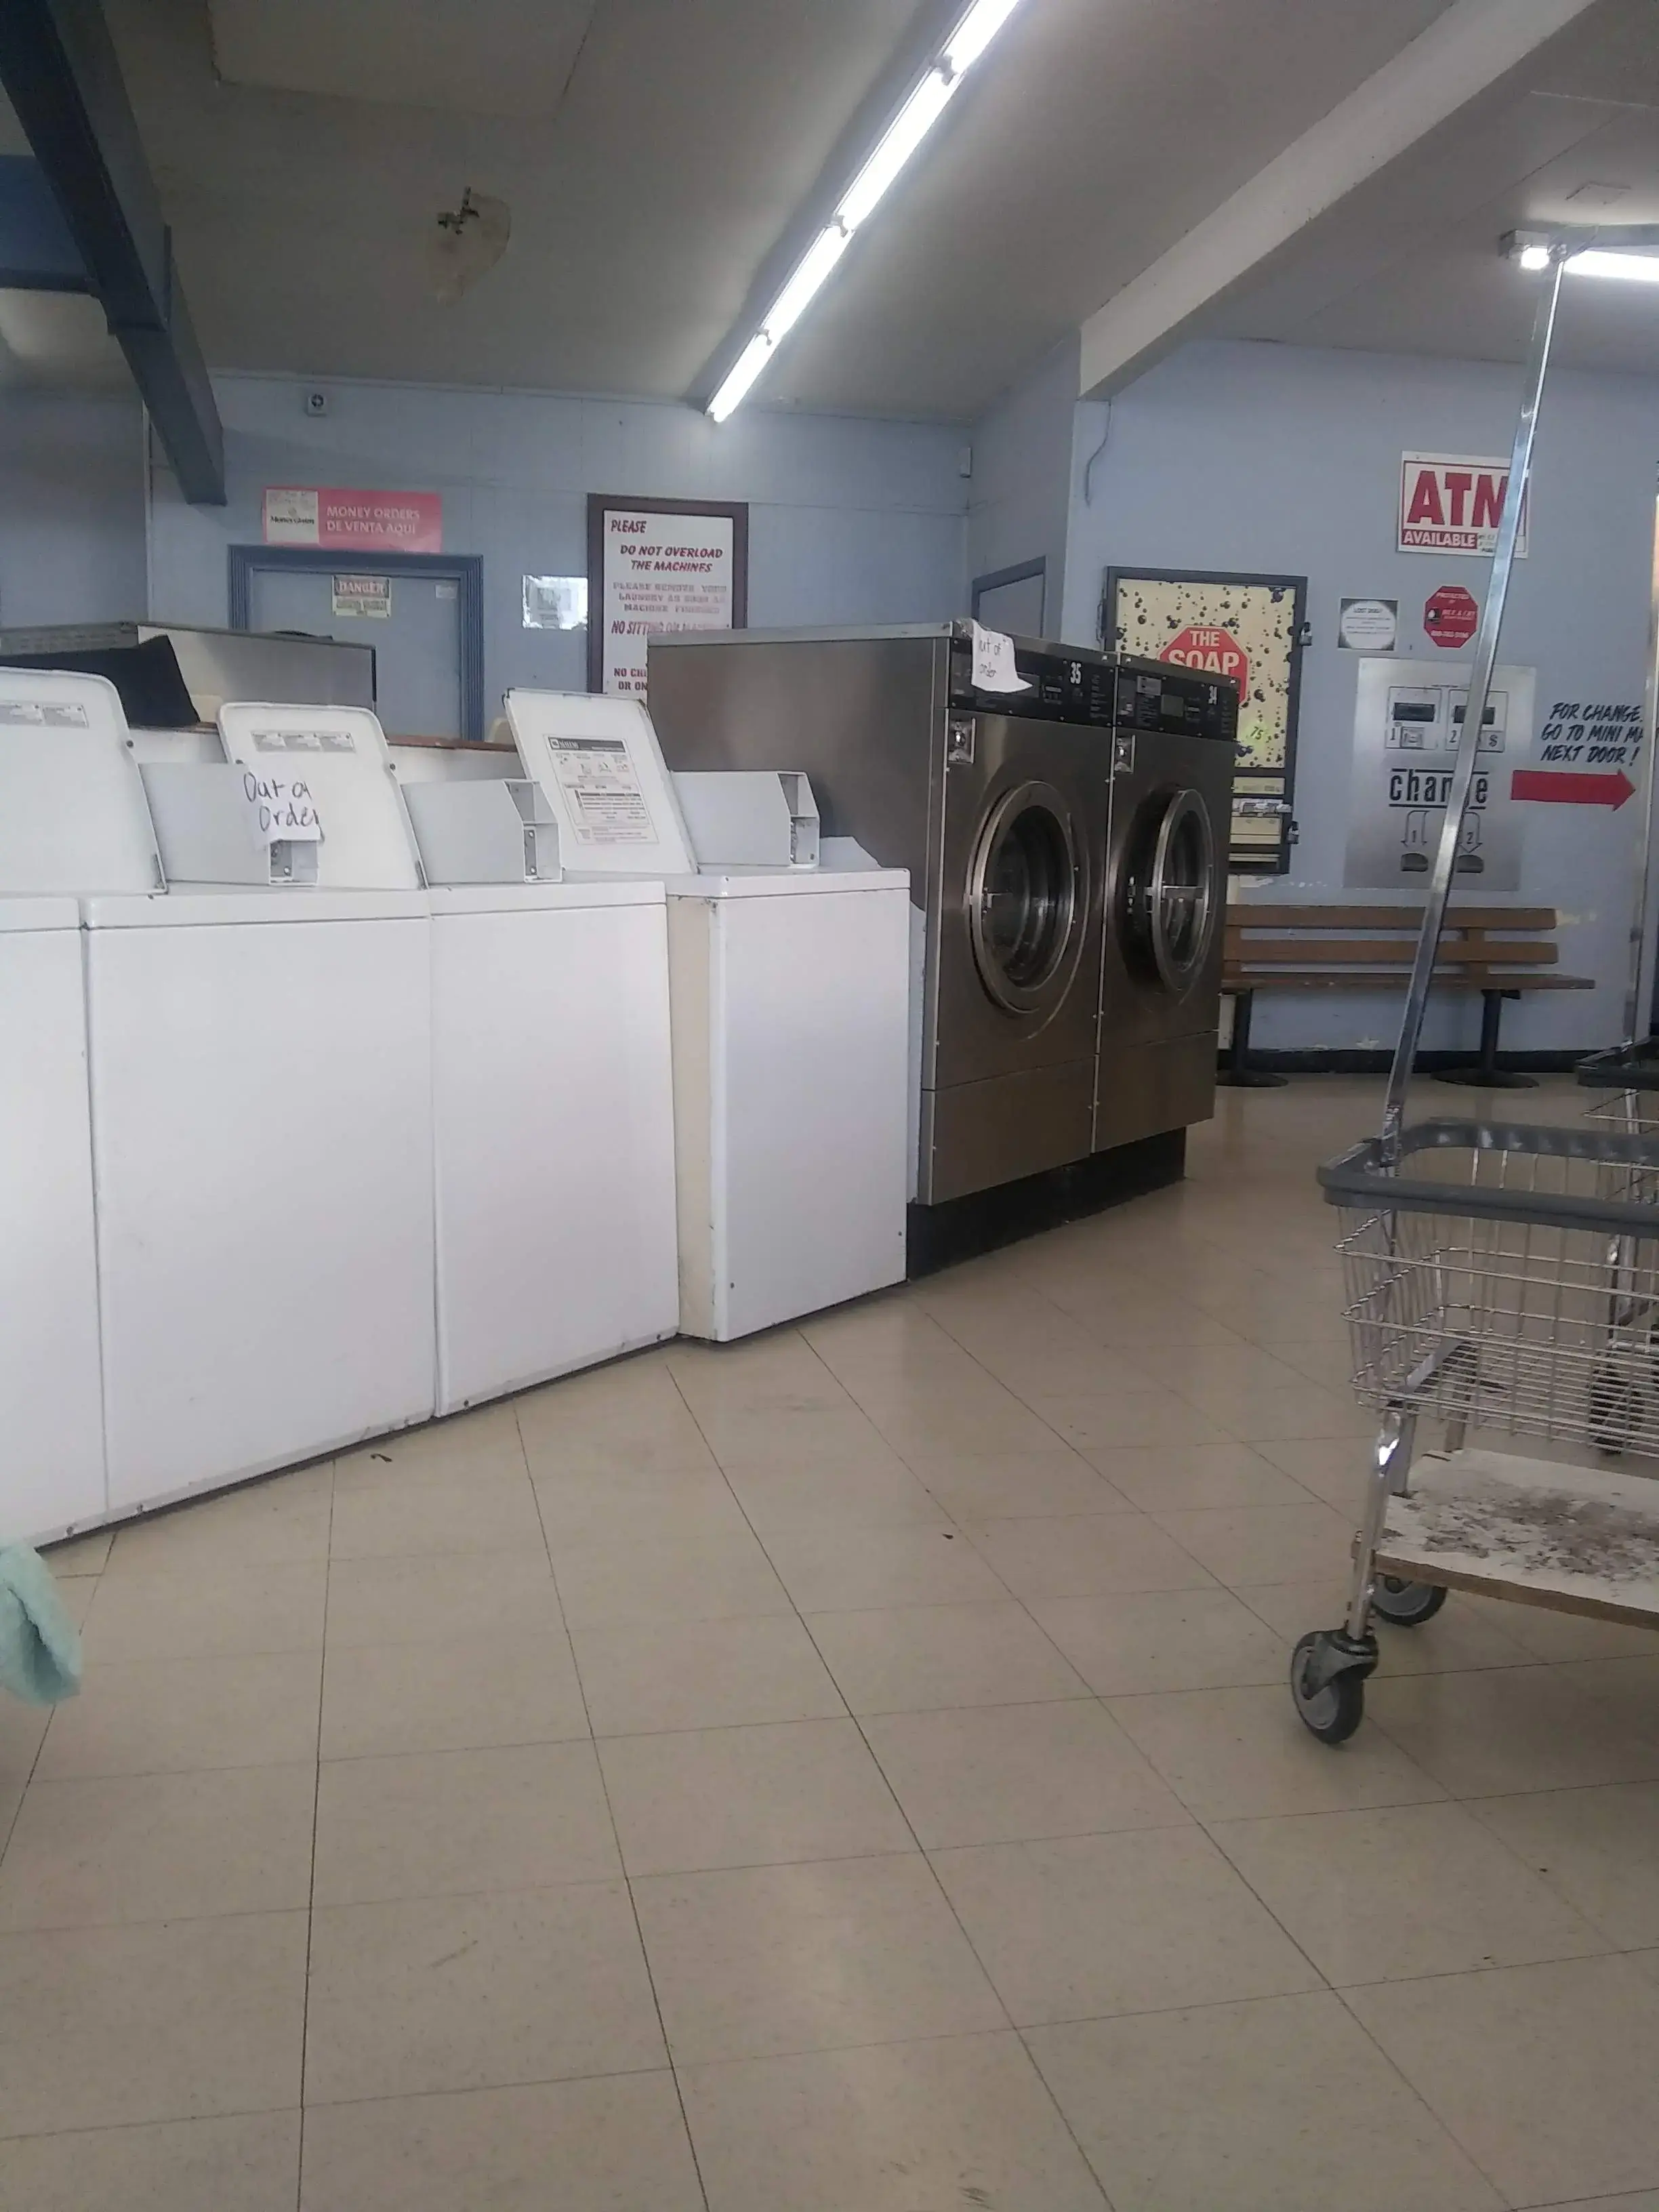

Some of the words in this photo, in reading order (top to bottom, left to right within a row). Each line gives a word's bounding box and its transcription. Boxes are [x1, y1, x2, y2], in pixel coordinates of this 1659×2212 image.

[326, 506, 371, 519] MONEY
[373, 509, 421, 520] ORDERS
[326, 520, 342, 532] DE
[345, 522, 384, 534] VENTA
[611, 520, 647, 534] PLEASE
[1403, 531, 1475, 548] AVAILABLE
[620, 544, 636, 556] DO
[638, 546, 663, 557] NOT
[665, 548, 723, 559] OVERLOAD
[631, 560, 651, 571] THE
[654, 561, 712, 573] MACHINES
[339, 580, 385, 595] DANGER
[611, 620, 625, 635] NO
[1189, 630, 1221, 647] THE
[1168, 649, 1240, 676] SOAP
[613, 668, 627, 676] NO
[1070, 661, 1082, 684] 35
[618, 680, 631, 690] OR
[1208, 684, 1218, 705] 34
[1549, 702, 1580, 720] FOR
[1541, 723, 1563, 741] GO
[1566, 724, 1585, 741] TO
[1586, 725, 1624, 743] MINI
[1540, 745, 1584, 762] NEXT
[1586, 746, 1627, 764] DOOR
[243, 771, 285, 802] Out
[1390, 769, 1488, 804] chane
